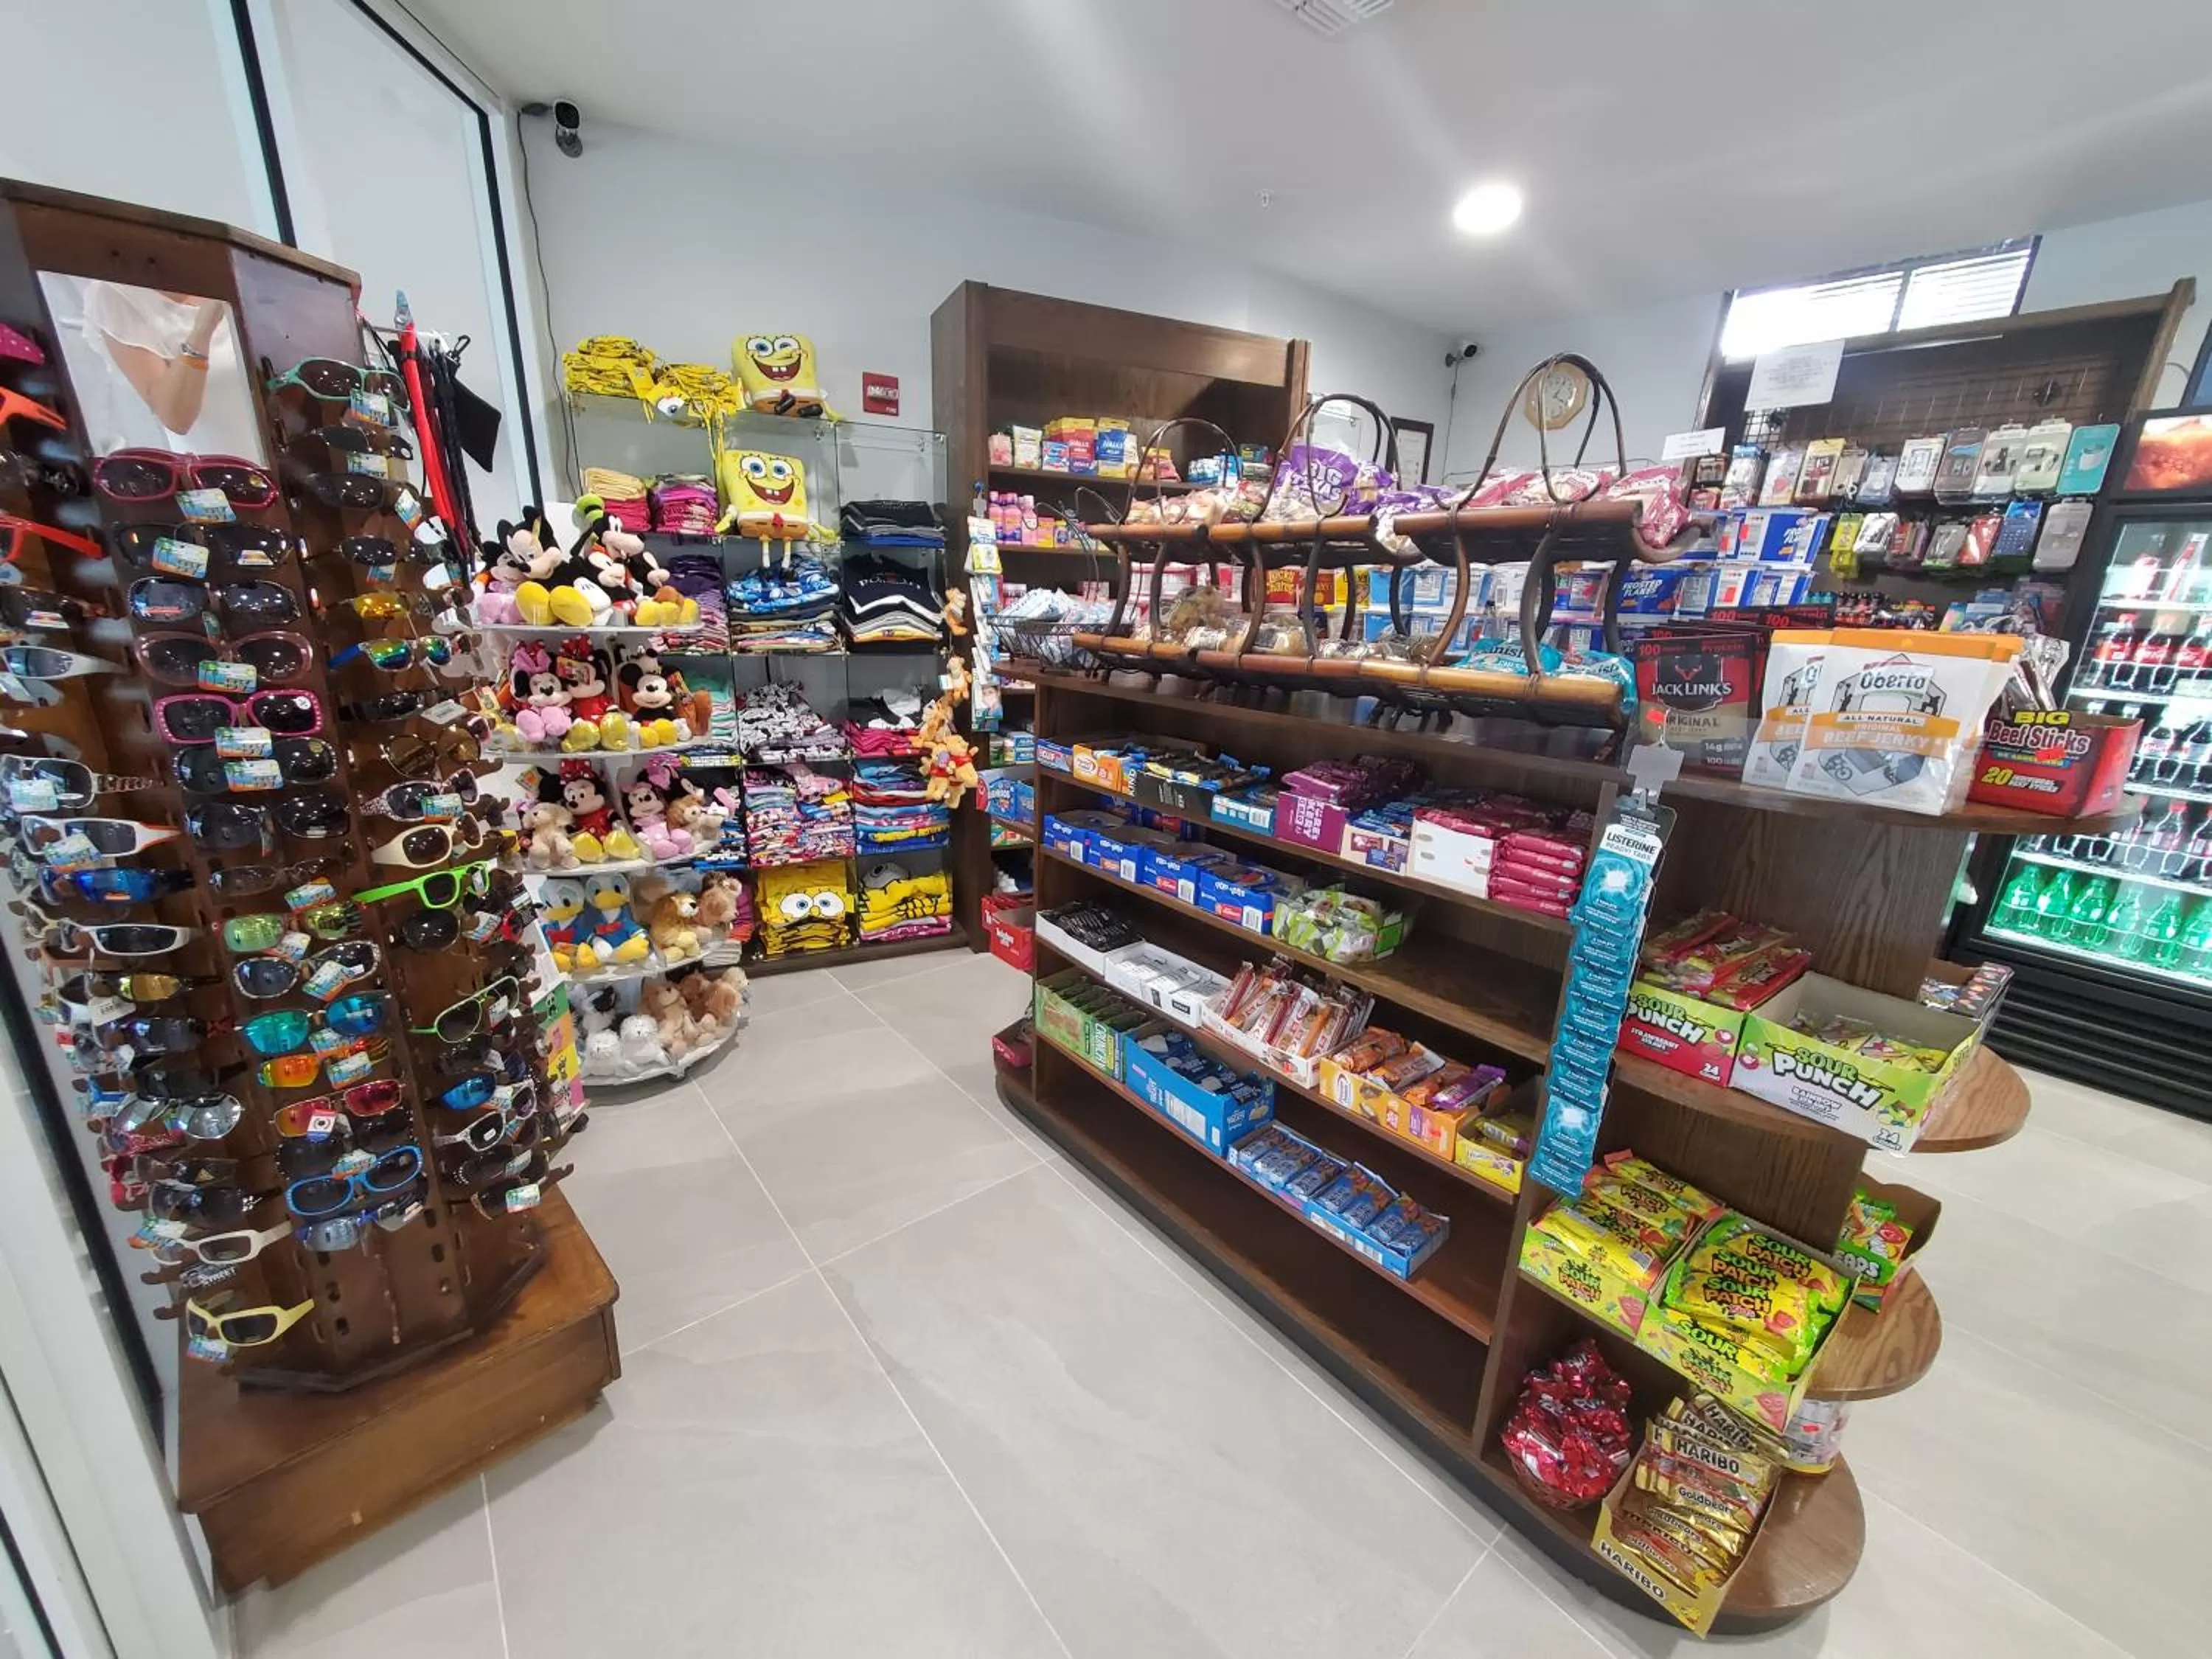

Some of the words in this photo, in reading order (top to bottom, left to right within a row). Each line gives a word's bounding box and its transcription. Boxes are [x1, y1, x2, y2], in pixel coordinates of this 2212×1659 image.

[1310, 459, 1343, 487] BIG
[1623, 579, 1663, 591] FROSTED
[1639, 644, 1660, 655] 100
[1652, 683, 1683, 696] JACK
[1860, 670, 1926, 690] Oberto
[1867, 715, 1920, 725] NATURAL
[2014, 711, 2070, 725] BIG
[1868, 734, 1930, 748] JERKY
[1990, 720, 2029, 747] Beef
[2028, 725, 2091, 755] Sticks
[1981, 766, 2013, 785] 20
[1607, 832, 1657, 855] LISTERINE
[1636, 993, 1687, 1022] SOUR
[1627, 1001, 1706, 1046] PUNCH
[1703, 1062, 1720, 1076] 24
[1794, 1046, 1860, 1082] SOUR
[1772, 1048, 1885, 1111] PUNCH
[1878, 1127, 1901, 1144] 24
[1747, 1243, 1812, 1277] PATCH
[1753, 1234, 1812, 1265] SOUR
[1562, 1264, 1601, 1287] SOUR
[1712, 1258, 1778, 1290] PATCH
[1714, 1251, 1777, 1279] SOUR
[1558, 1270, 1602, 1302] PATCH
[1707, 1276, 1769, 1299] SOUR
[1703, 1288, 1773, 1314] PATCH
[1678, 1319, 1739, 1363] SOUR
[1680, 1351, 1733, 1382] SOUR
[1676, 1439, 1740, 1474] HARIBO
[1678, 1486, 1731, 1514] Goldbear
[1601, 1540, 1666, 1600] HARIBO
